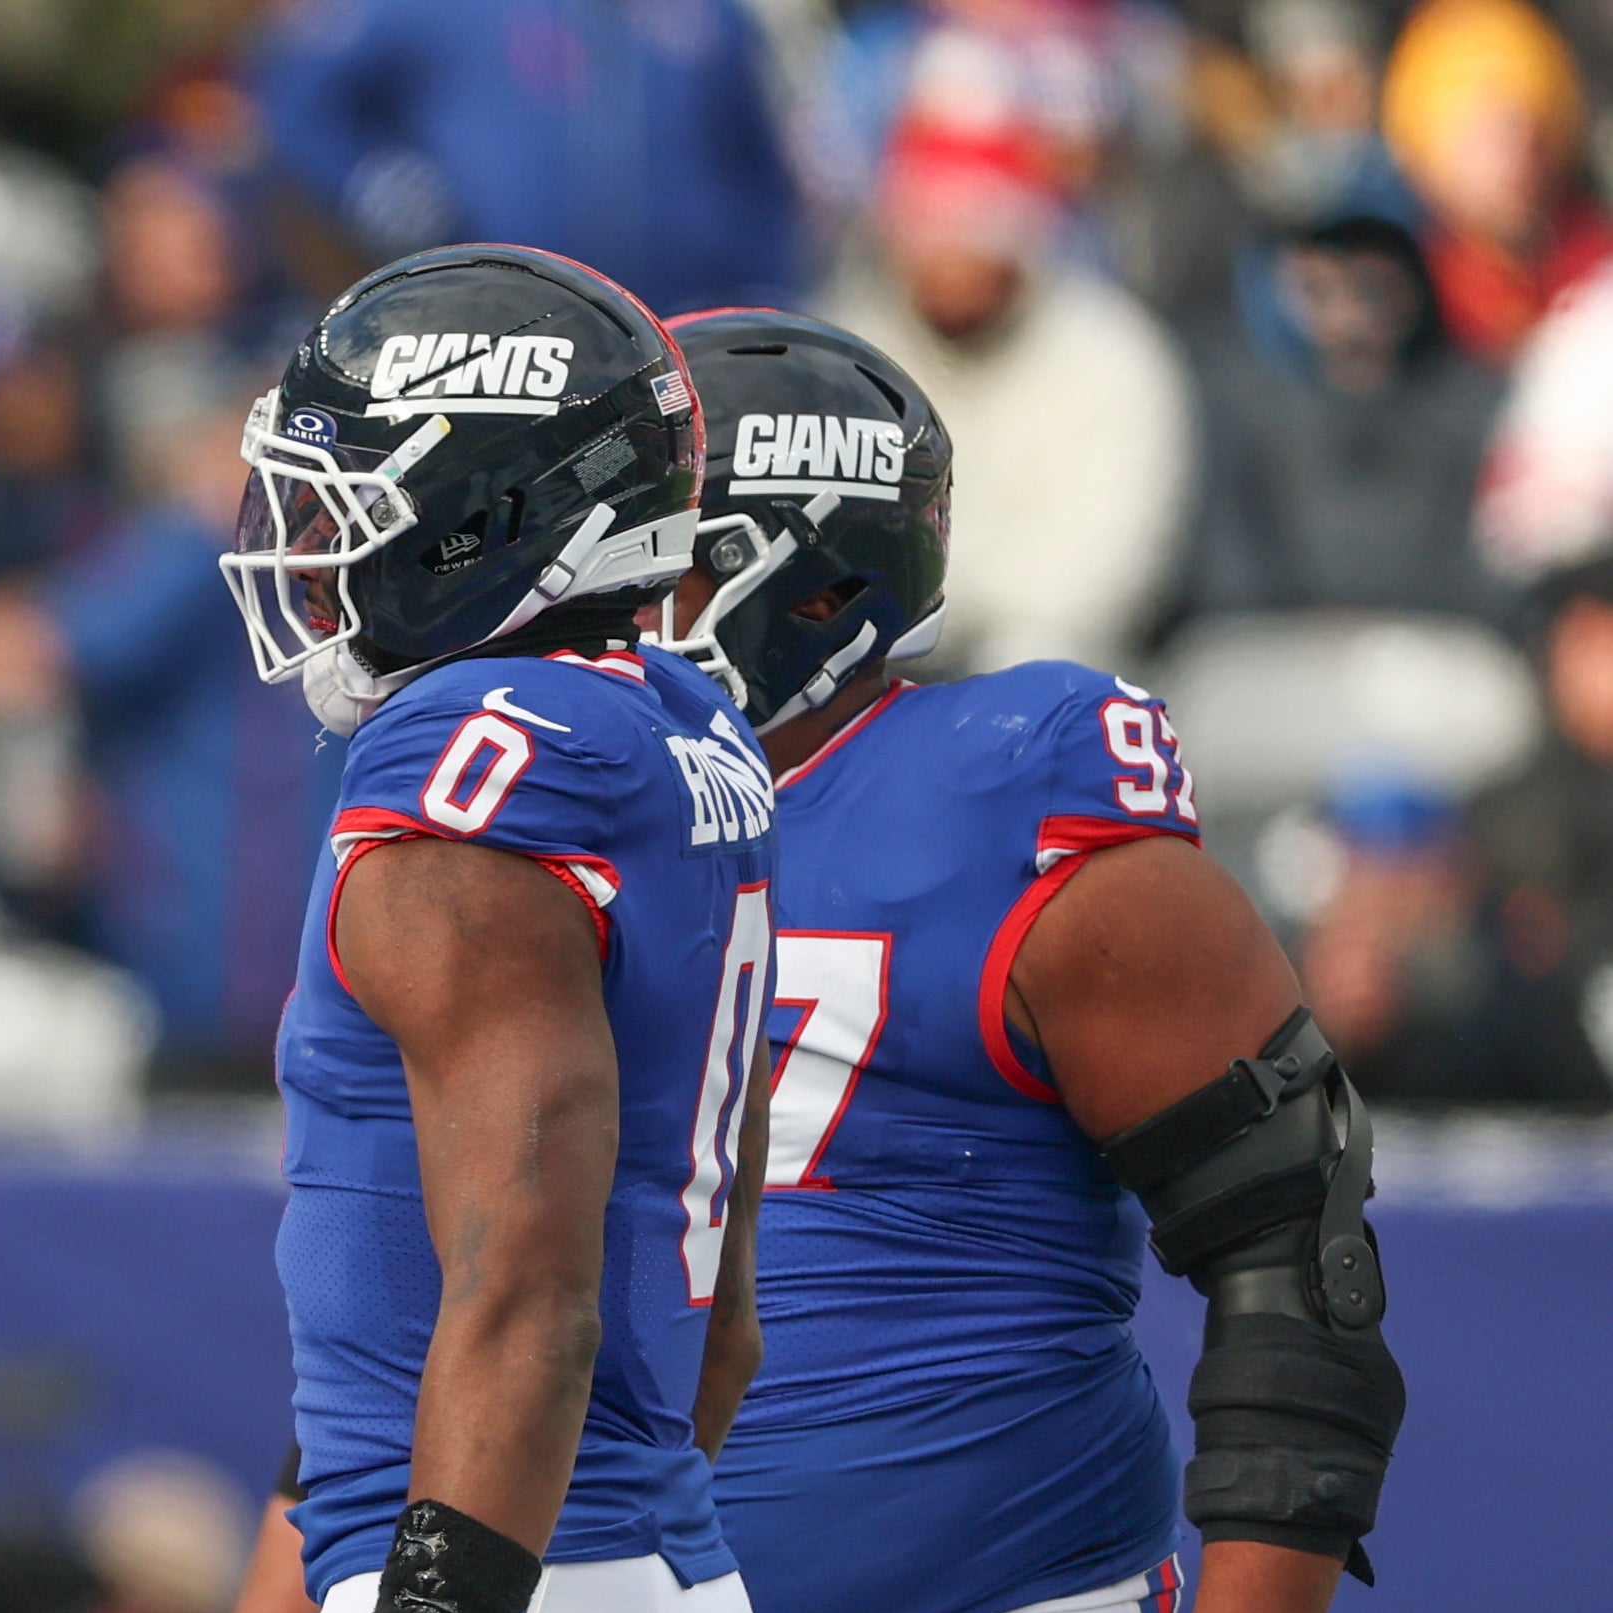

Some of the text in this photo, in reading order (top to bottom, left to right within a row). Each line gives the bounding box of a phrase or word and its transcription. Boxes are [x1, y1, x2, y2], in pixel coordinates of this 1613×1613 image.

[371, 333, 574, 399] GIANTS
[287, 428, 331, 444] OAKLEY
[733, 414, 904, 483] GIANTS
[421, 709, 534, 839] 0
